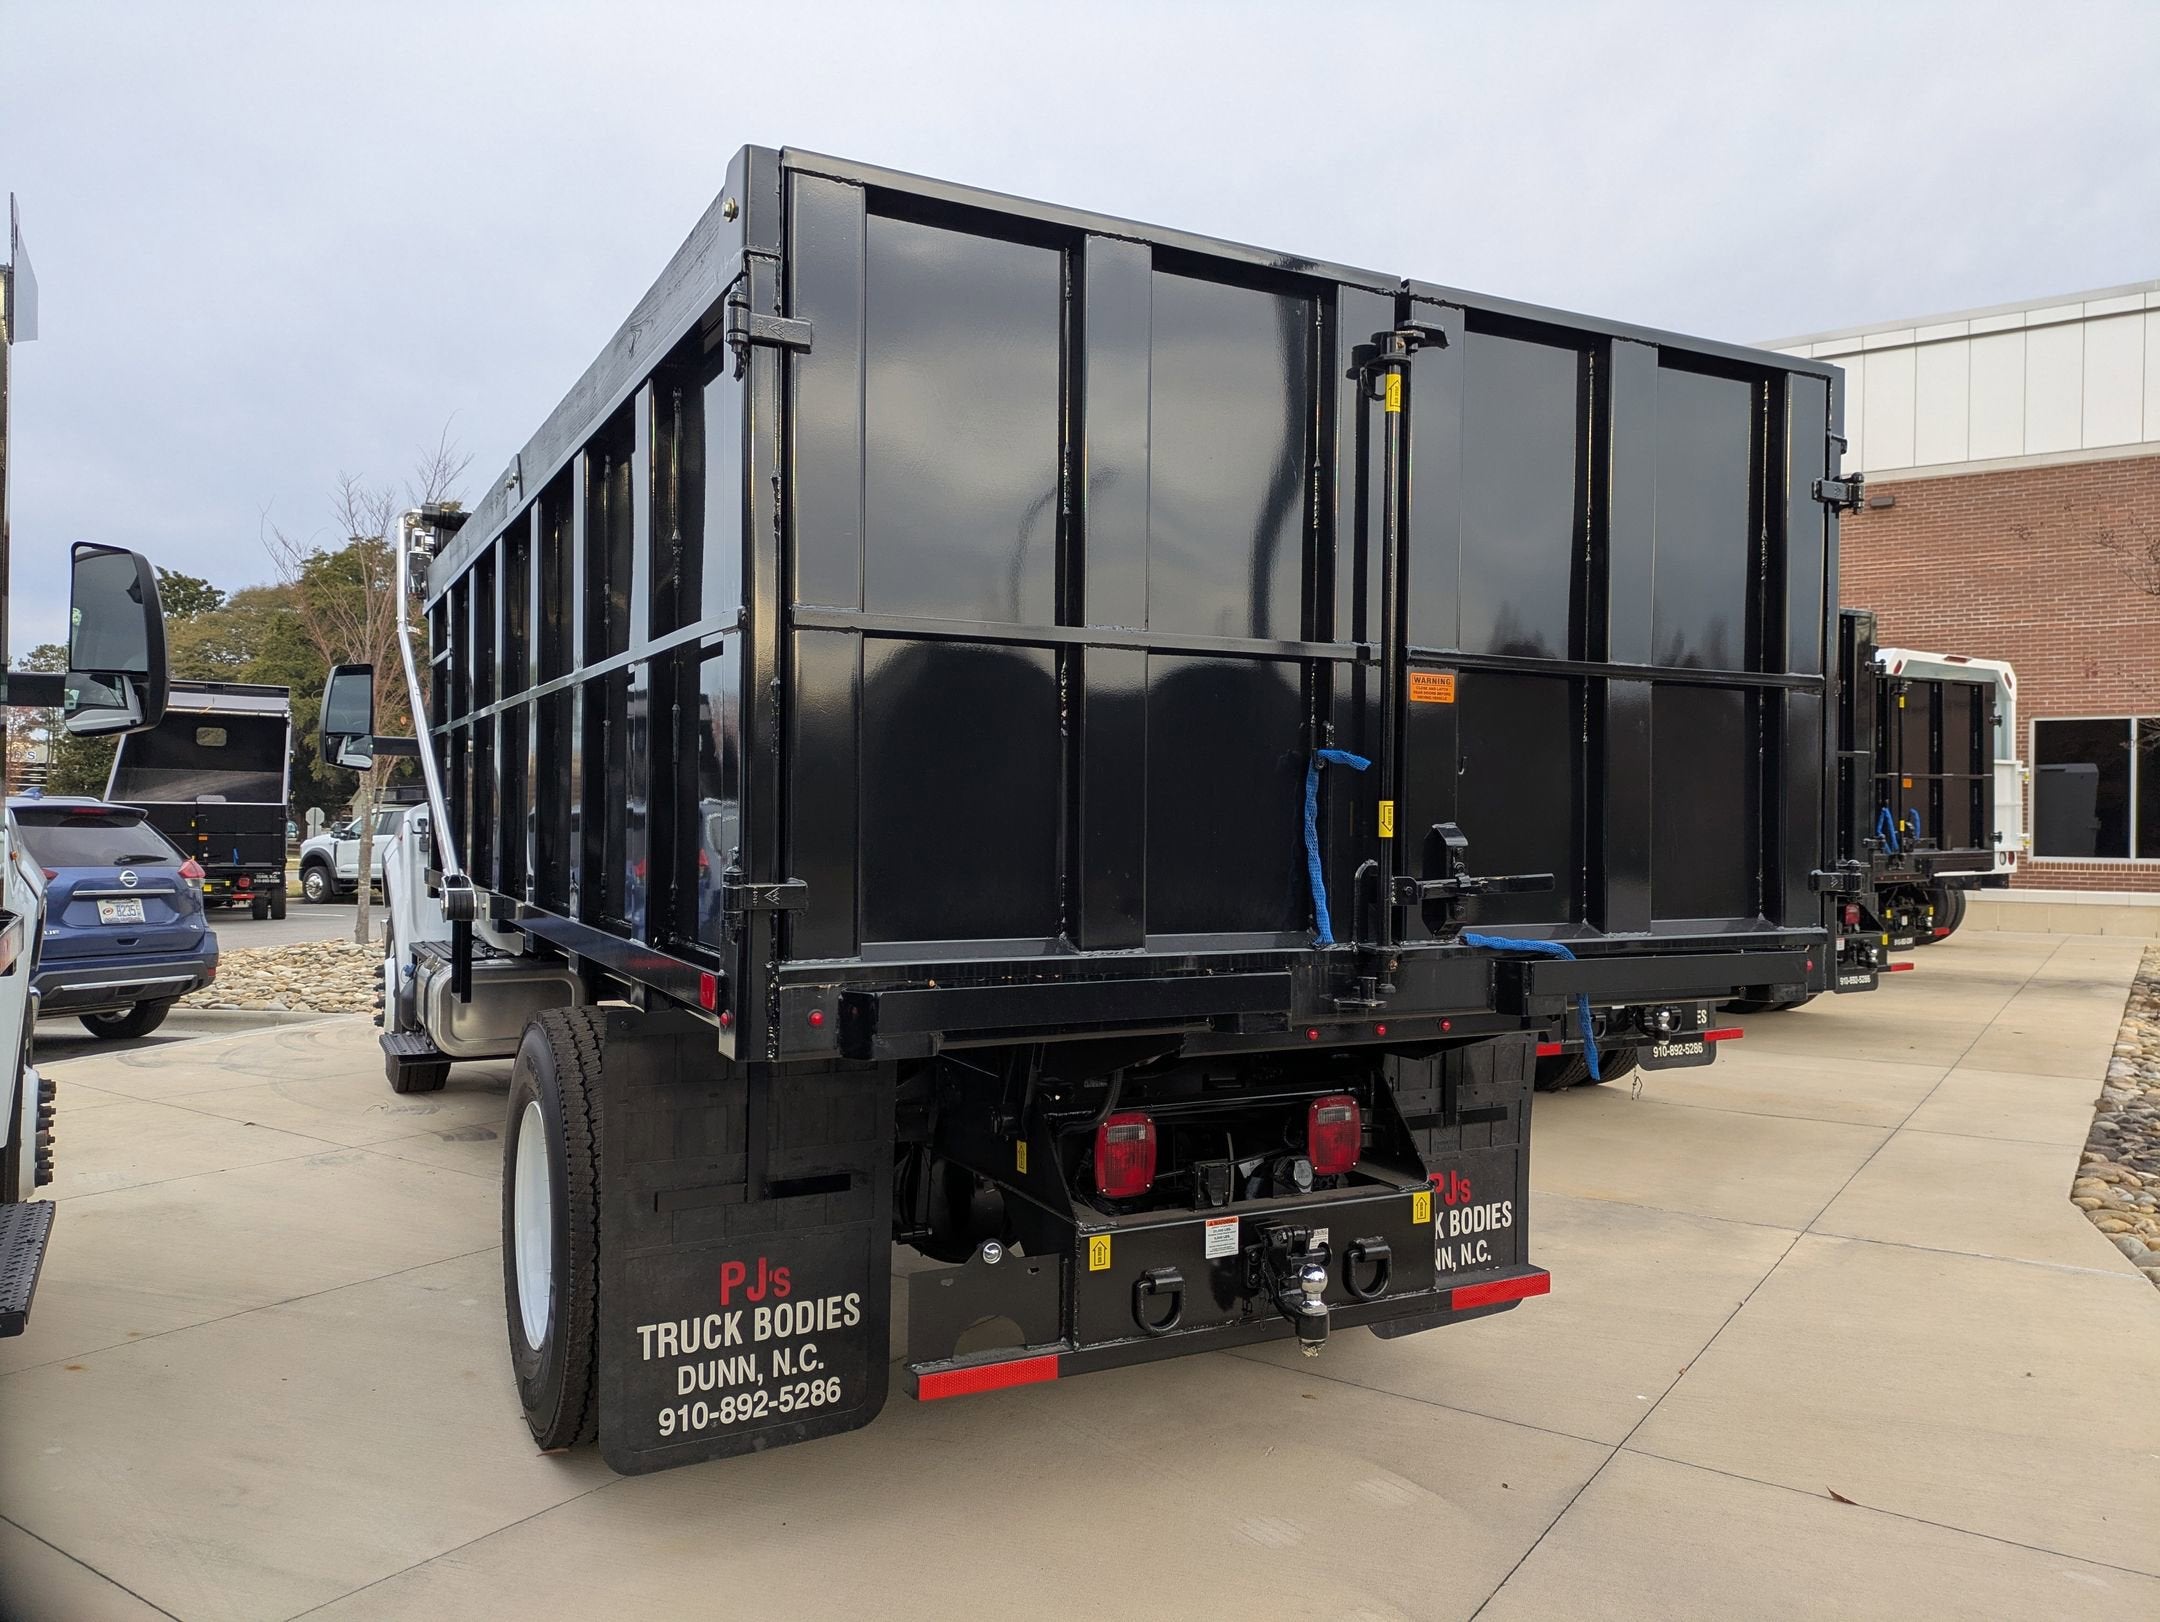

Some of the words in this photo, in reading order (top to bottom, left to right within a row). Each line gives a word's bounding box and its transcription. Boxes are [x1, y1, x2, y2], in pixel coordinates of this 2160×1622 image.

[1413, 676, 1451, 685] WARNING
[1653, 1042, 1704, 1058] 910-892-5286
[1449, 1200, 1512, 1237] BODIES
[1460, 1239, 1492, 1266] N.C.
[720, 1256, 792, 1306] PJ's
[636, 1310, 743, 1361] TRUCK
[754, 1292, 861, 1342] BODIES
[677, 1353, 764, 1396] DUNN,
[773, 1343, 824, 1378] N.C.
[657, 1376, 842, 1436] 910-892-5286
